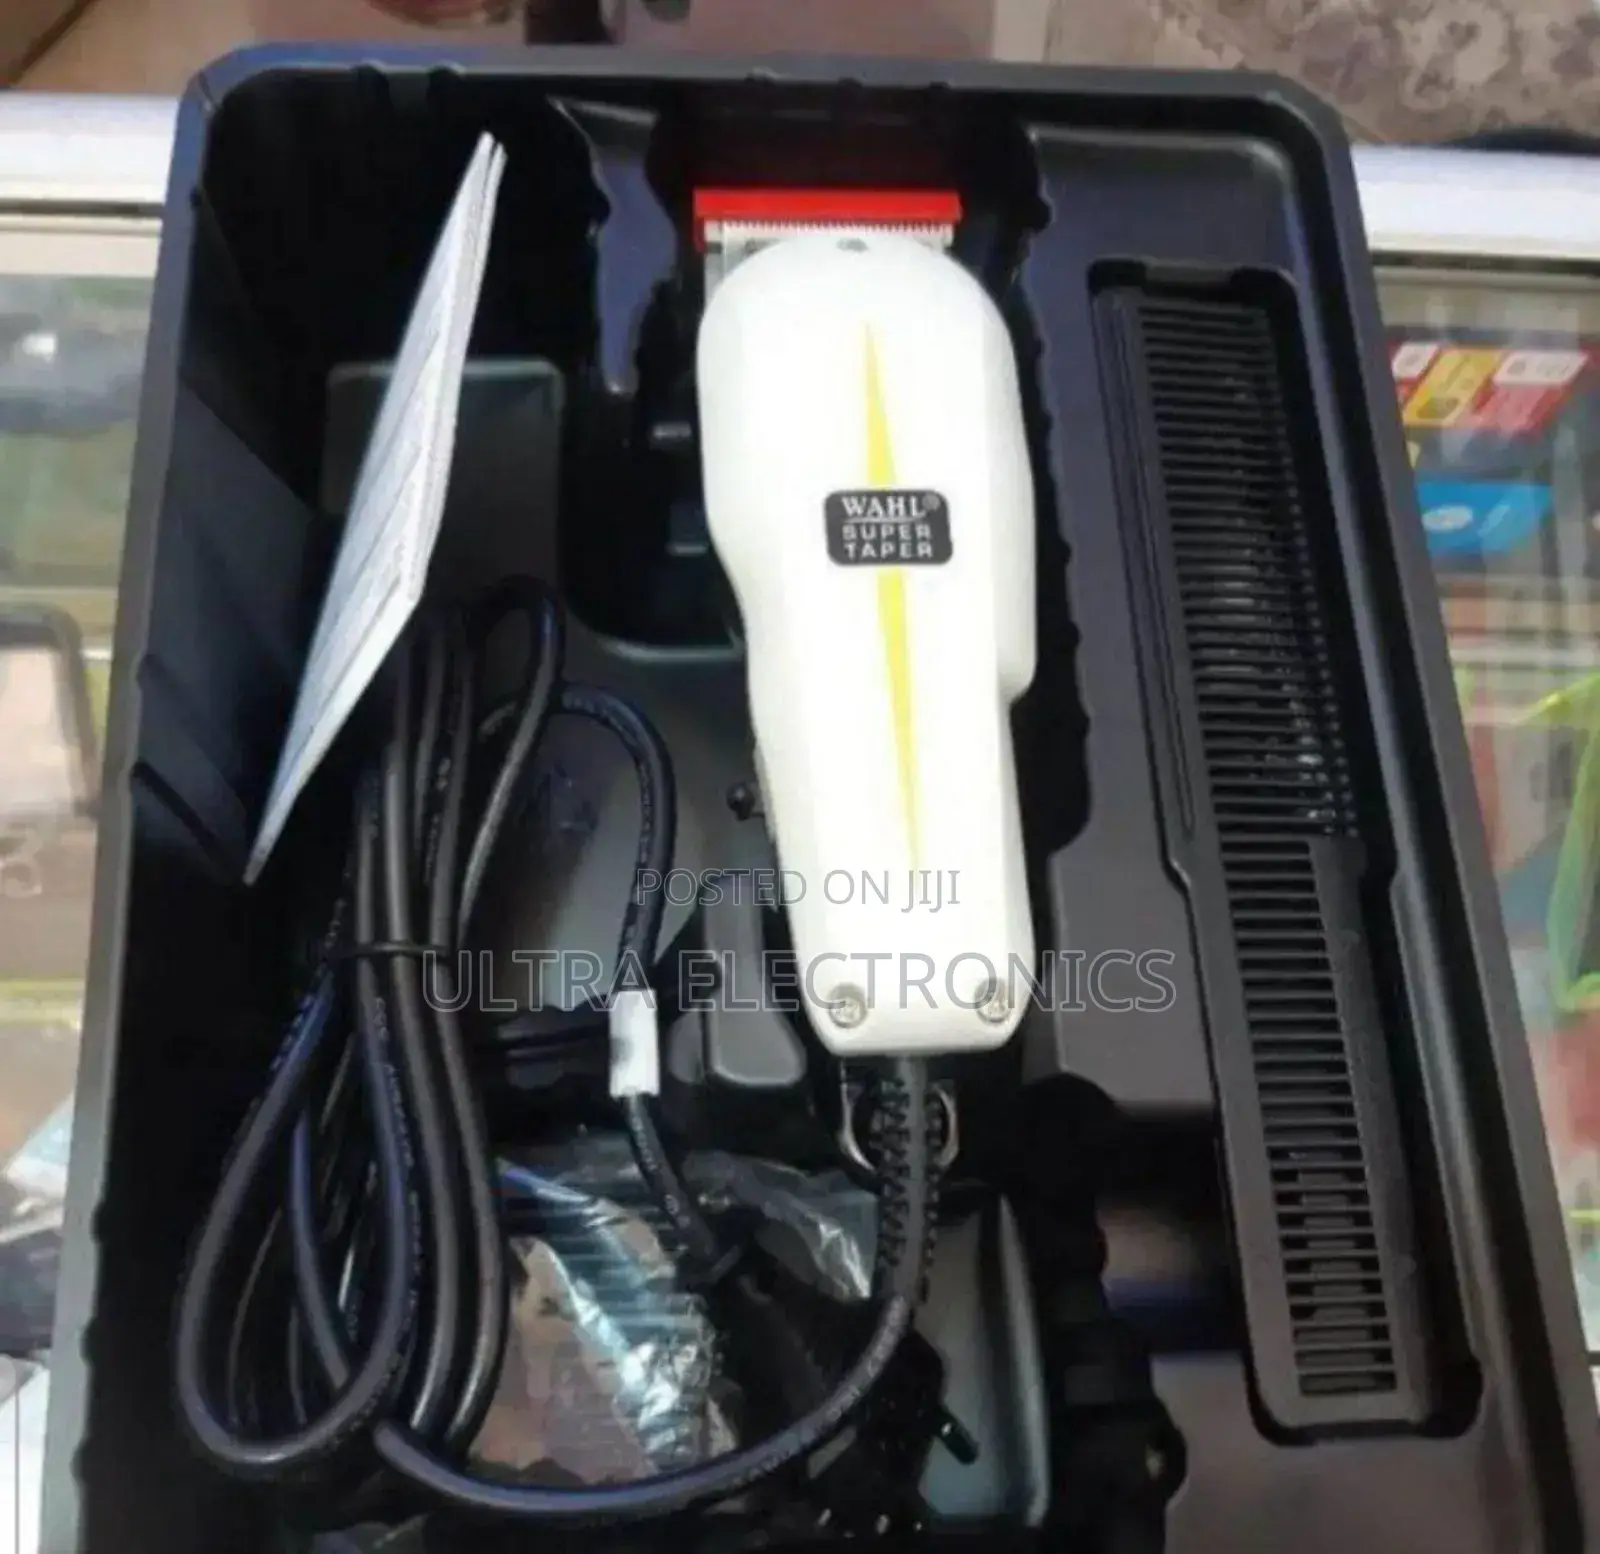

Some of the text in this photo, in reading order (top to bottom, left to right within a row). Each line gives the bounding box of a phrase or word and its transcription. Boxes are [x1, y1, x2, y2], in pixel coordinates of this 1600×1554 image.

[842, 496, 927, 519] WAHL
[842, 524, 932, 541] SUPER
[844, 542, 933, 559] TAPER
